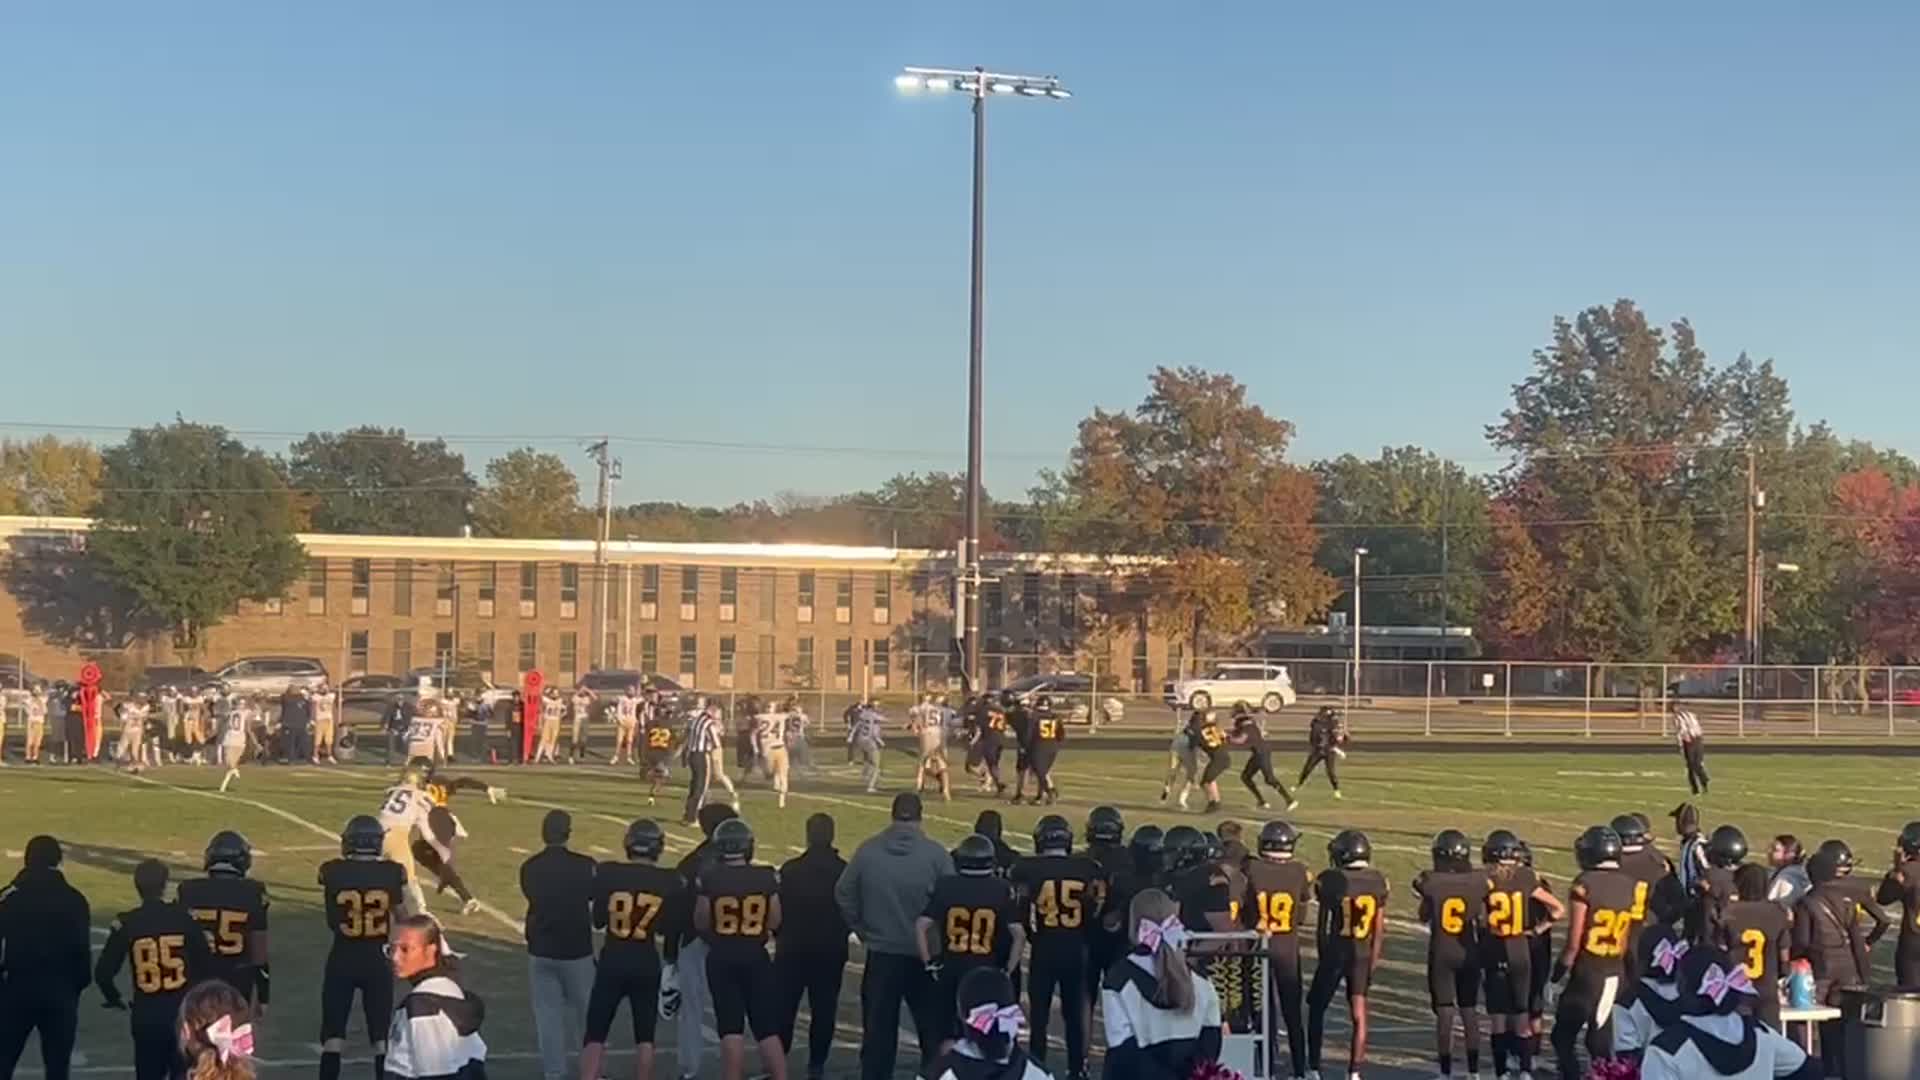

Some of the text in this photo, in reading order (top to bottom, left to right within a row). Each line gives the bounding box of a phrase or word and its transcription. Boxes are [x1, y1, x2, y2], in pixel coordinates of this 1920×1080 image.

[649, 727, 672, 748] 22
[760, 720, 780, 739] 24
[1039, 718, 1058, 739] 51
[336, 890, 391, 938] 32
[608, 892, 663, 940] 87
[713, 895, 769, 936] 68
[1036, 880, 1085, 928] 45
[1255, 890, 1296, 933] 19
[1340, 895, 1378, 939] 13
[1441, 897, 1466, 935] 6
[1487, 891, 1525, 937] 21
[947, 908, 996, 954] 60
[1585, 908, 1631, 956] 29
[1740, 928, 1766, 980] 3
[133, 934, 187, 993] 85
